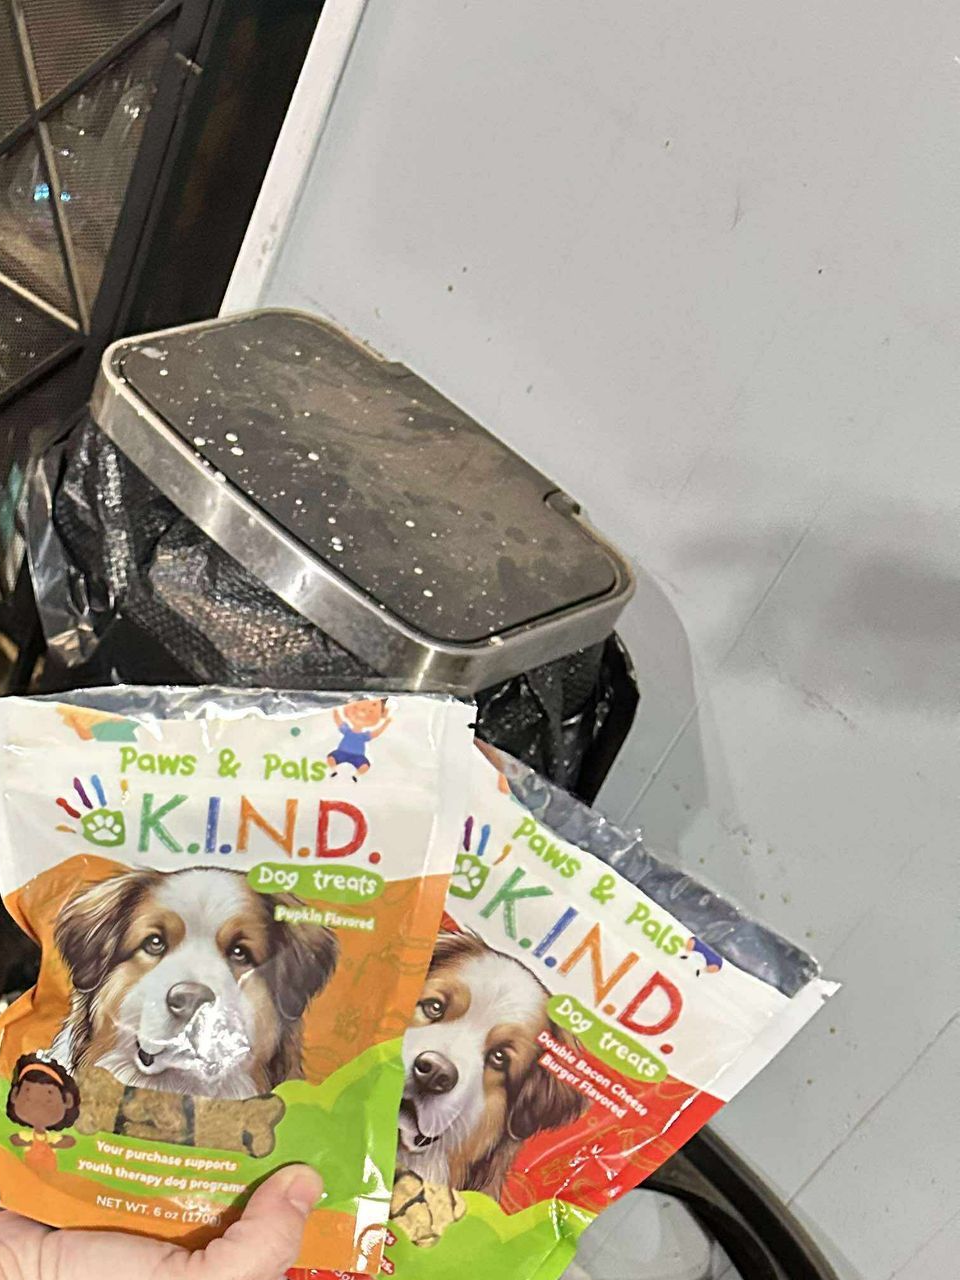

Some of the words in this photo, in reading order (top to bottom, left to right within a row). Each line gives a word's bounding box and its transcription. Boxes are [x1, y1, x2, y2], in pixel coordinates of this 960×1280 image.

[119, 746, 197, 777] Paws
[217, 748, 241, 779] &
[263, 753, 326, 782] Pals
[137, 793, 381, 865] K.I.N.D.
[258, 866, 299, 891] Dog
[313, 870, 378, 896] treats
[512, 816, 582, 879] Paws
[590, 873, 616, 905] &
[625, 902, 686, 956] Pals
[324, 911, 375, 931] Flavored
[479, 866, 683, 1055] K.I.N.D.
[555, 998, 593, 1033] Dog
[599, 1031, 660, 1078] treats
[537, 1031, 577, 1064] Double
[575, 1059, 612, 1088] Bacon
[610, 1083, 649, 1116] Cheese
[541, 1053, 581, 1085] Burger
[578, 1080, 628, 1119] Flavored
[77, 1159, 113, 1176] youth
[115, 1167, 163, 1187] therapy
[164, 1175, 188, 1190] dog
[97, 1140, 123, 1156] Your
[125, 1149, 182, 1167] purchase
[184, 1158, 238, 1172] supports
[96, 1195, 123, 1208] NET
[125, 1201, 150, 1214] WT.
[153, 1206, 162, 1217] 6
[164, 1210, 179, 1221] oz
